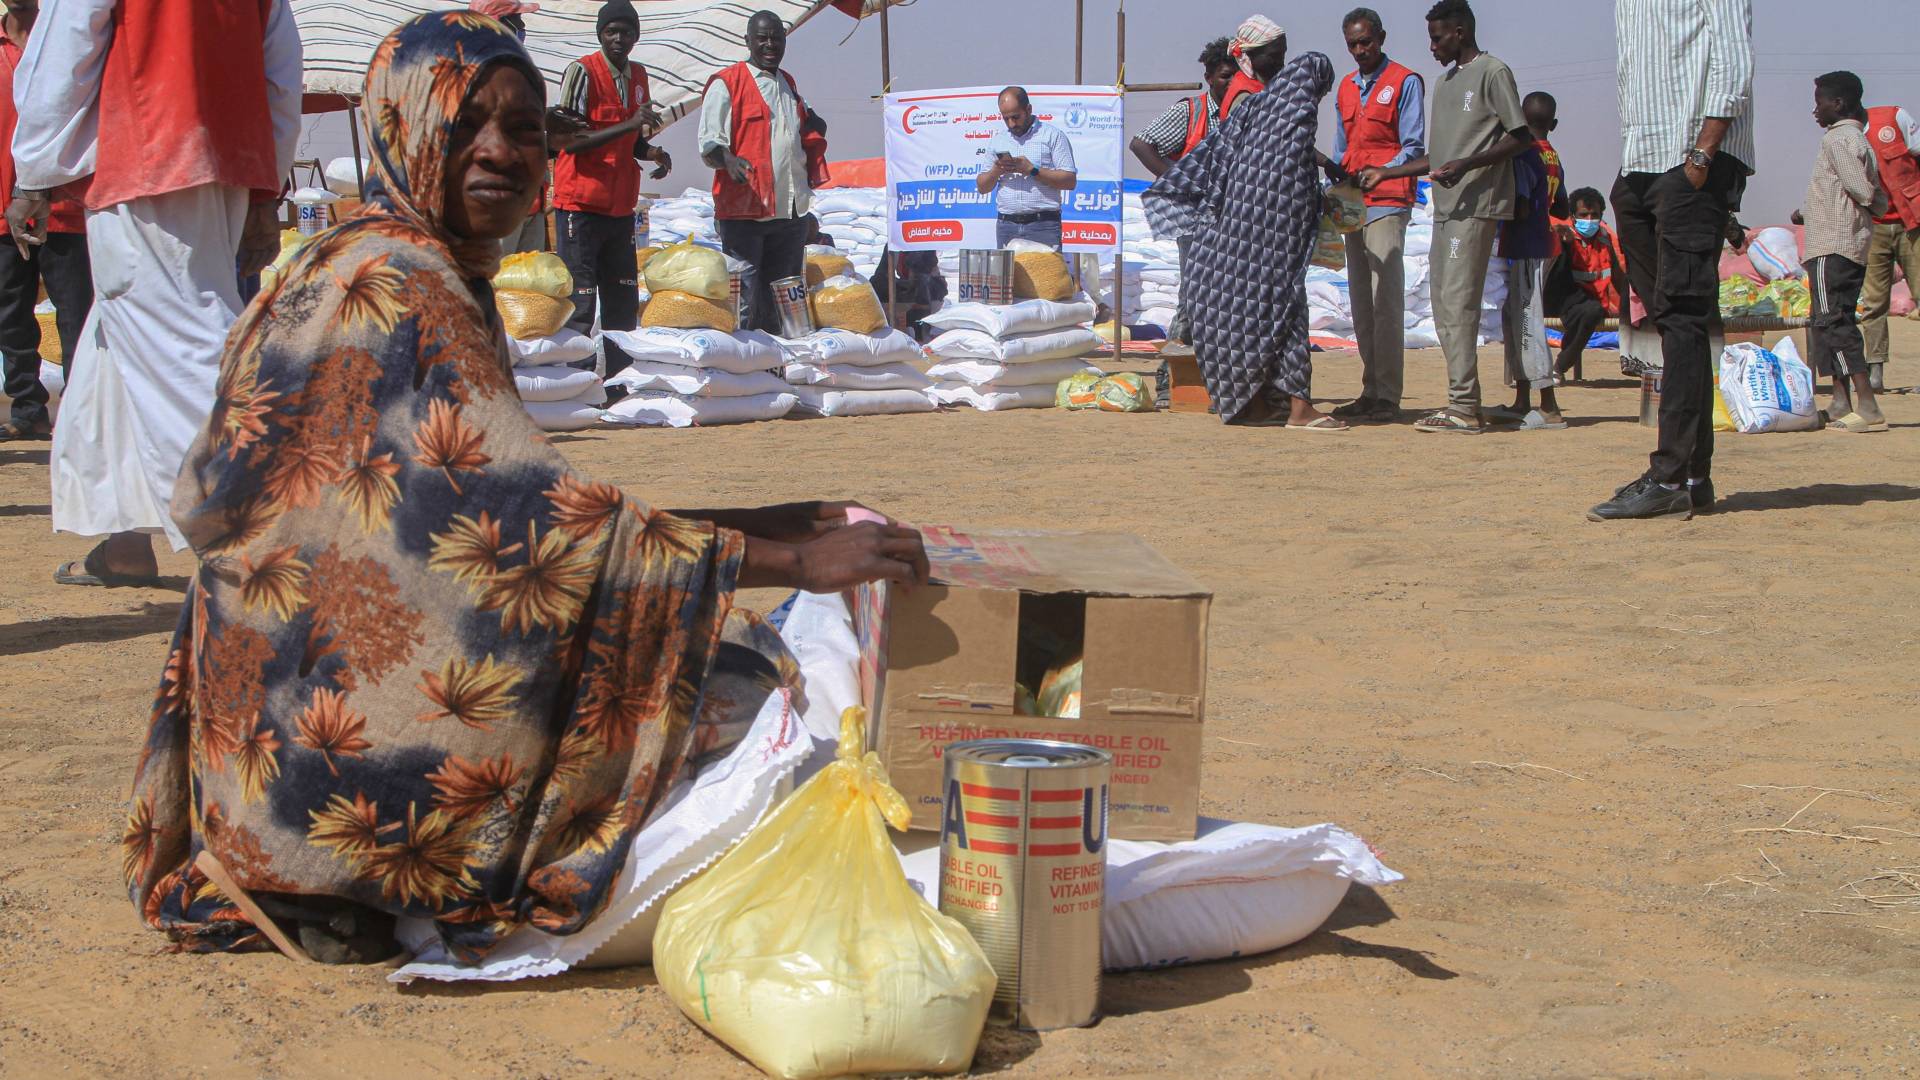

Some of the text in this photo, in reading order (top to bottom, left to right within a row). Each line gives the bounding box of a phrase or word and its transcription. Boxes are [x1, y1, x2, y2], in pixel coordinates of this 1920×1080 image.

[1090, 115, 1111, 123] World
[925, 163, 954, 178] (WFP)
[1074, 189, 1120, 211] توزيع
[788, 284, 806, 302] US
[1759, 372, 1770, 401] Wheat
[920, 724, 1008, 741] REFINED
[1138, 735, 1171, 752] OIL
[1112, 752, 1162, 769] IFIED
[943, 779, 968, 849] A
[1083, 784, 1107, 853] U
[976, 863, 1003, 880] OIL
[1051, 861, 1103, 881] REFINED
[944, 873, 1003, 896] ORTIFIED
[1050, 880, 1099, 899] VITAMIN
[944, 893, 999, 911] CHANGED
[1053, 903, 1075, 914] NOT
[1078, 901, 1089, 912] TO
